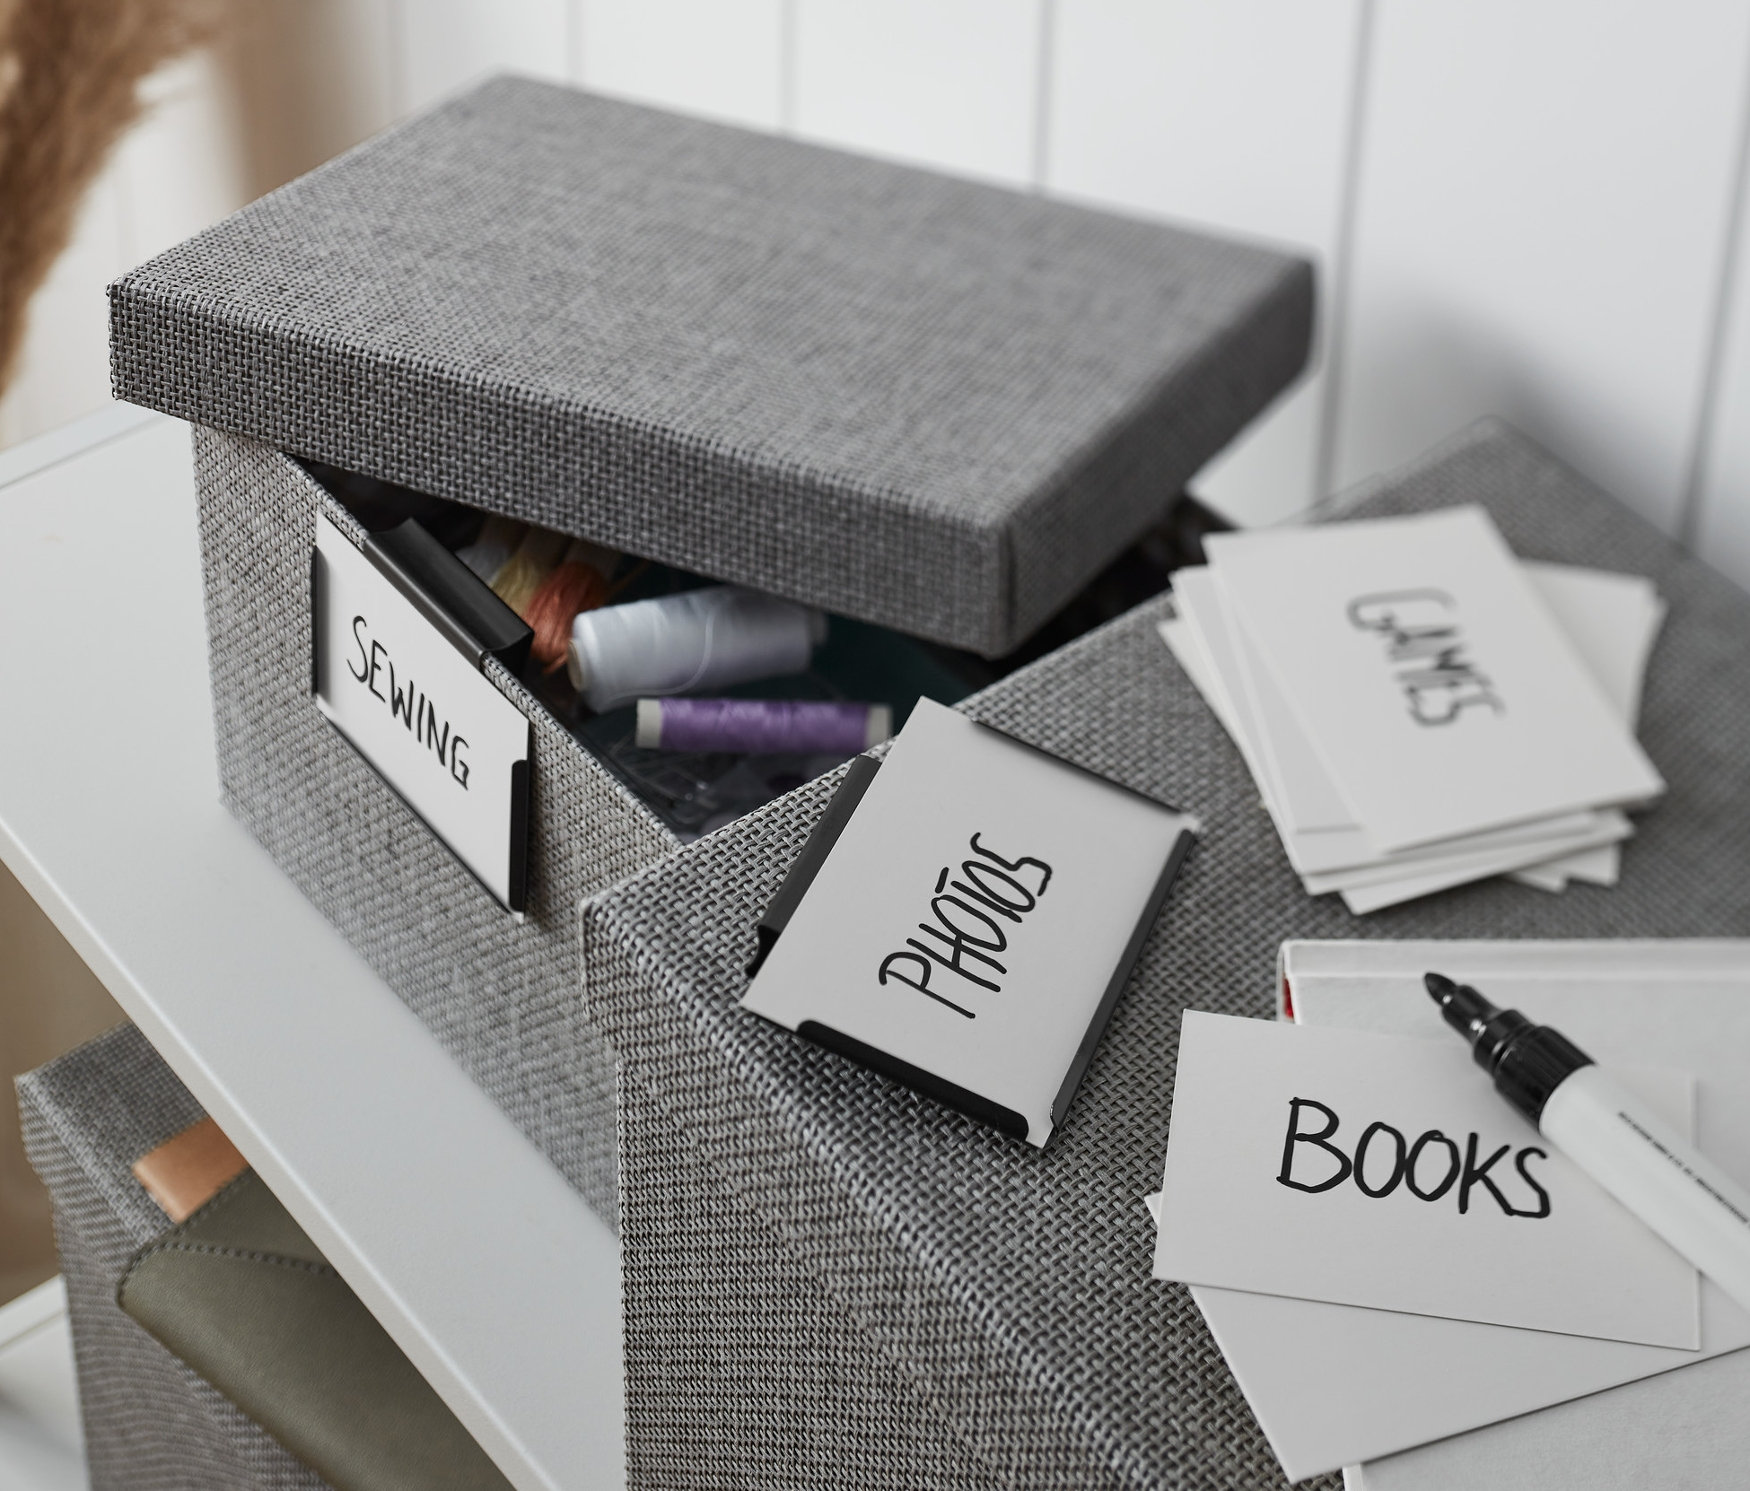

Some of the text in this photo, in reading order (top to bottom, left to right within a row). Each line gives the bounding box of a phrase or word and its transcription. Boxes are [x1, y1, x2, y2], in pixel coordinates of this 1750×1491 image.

[346, 615, 470, 791] SEWING
[1346, 587, 1507, 730] GAMES
[878, 831, 1053, 1020] PHOTOS
[1275, 1096, 1552, 1220] BOOKS
